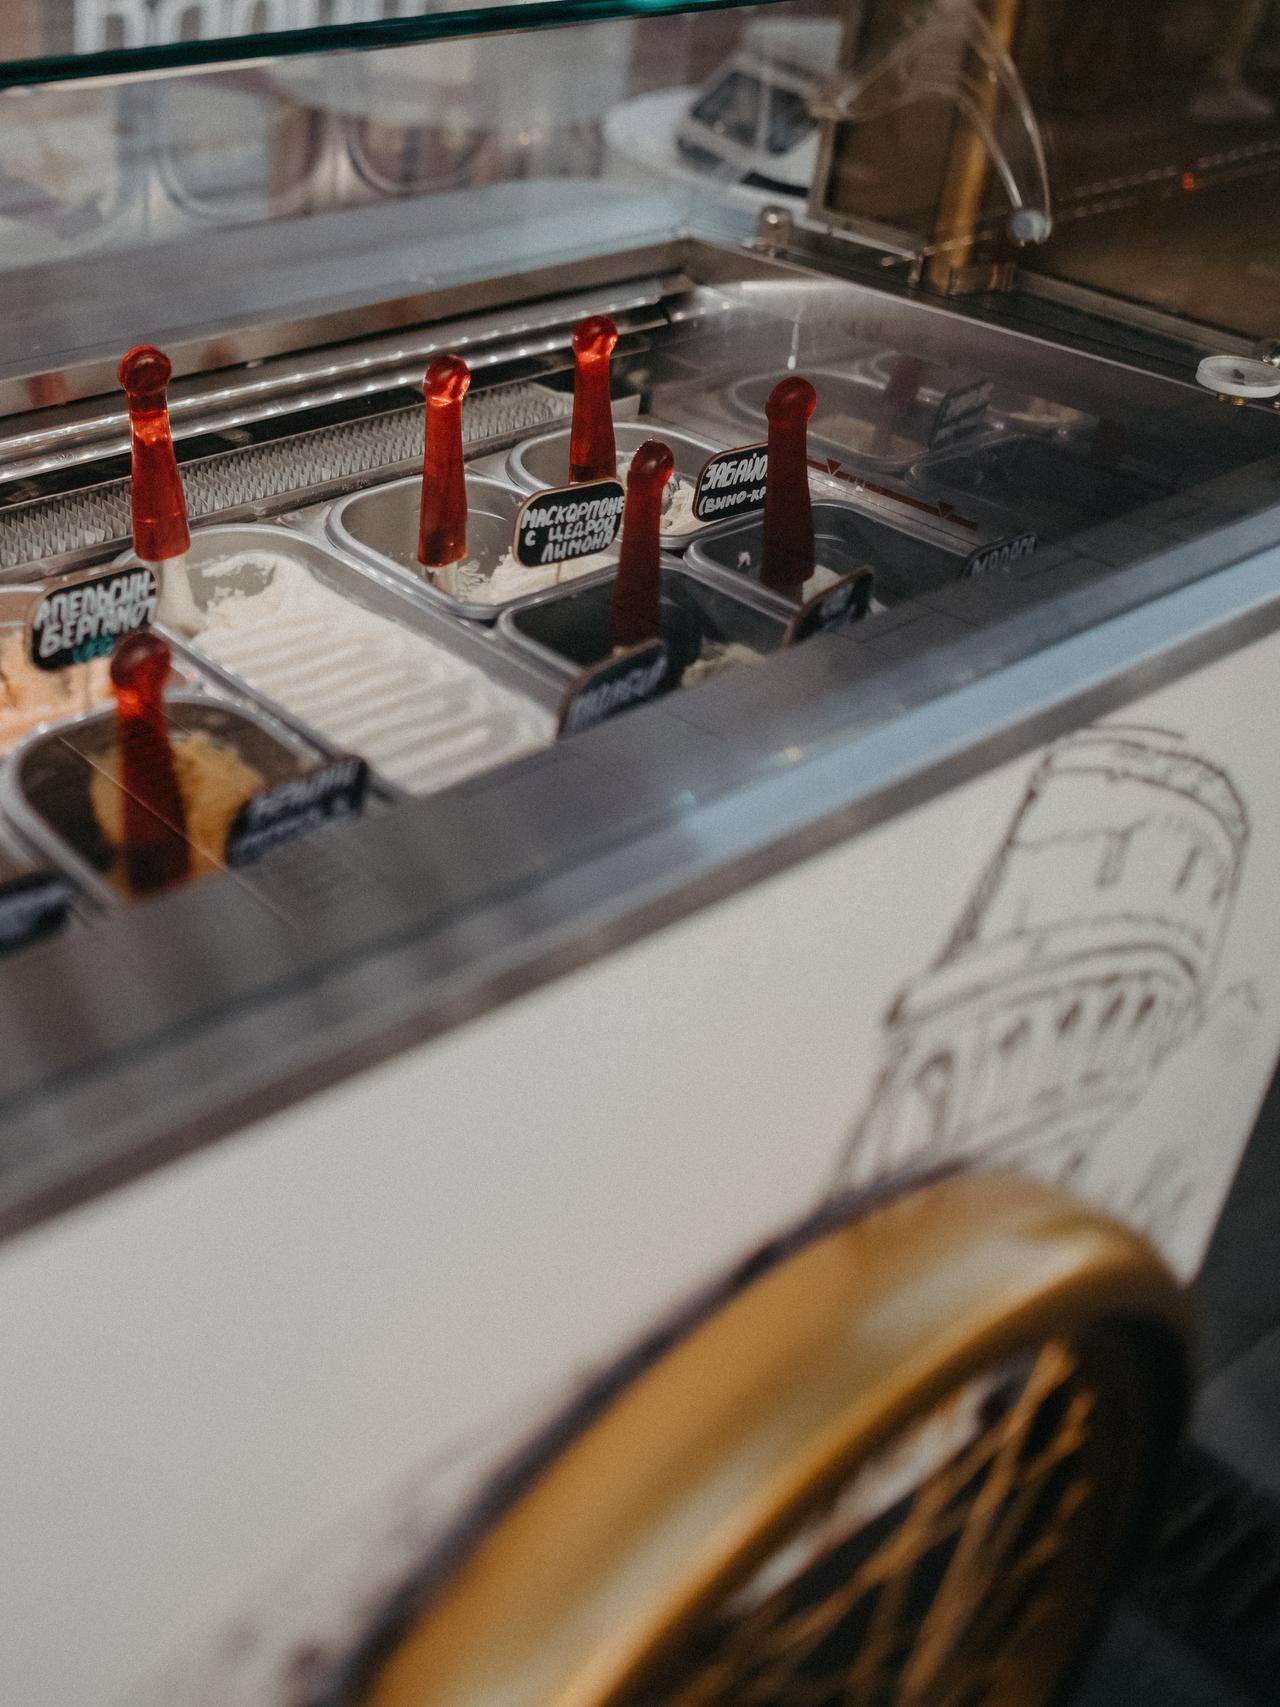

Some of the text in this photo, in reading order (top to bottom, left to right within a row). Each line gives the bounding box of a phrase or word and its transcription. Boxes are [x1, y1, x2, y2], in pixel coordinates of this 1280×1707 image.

[701, 453, 768, 491] ЗАБАЙО
[541, 527, 615, 562] ЛИМОНА
[548, 514, 617, 542] ЦЕДРОЙ
